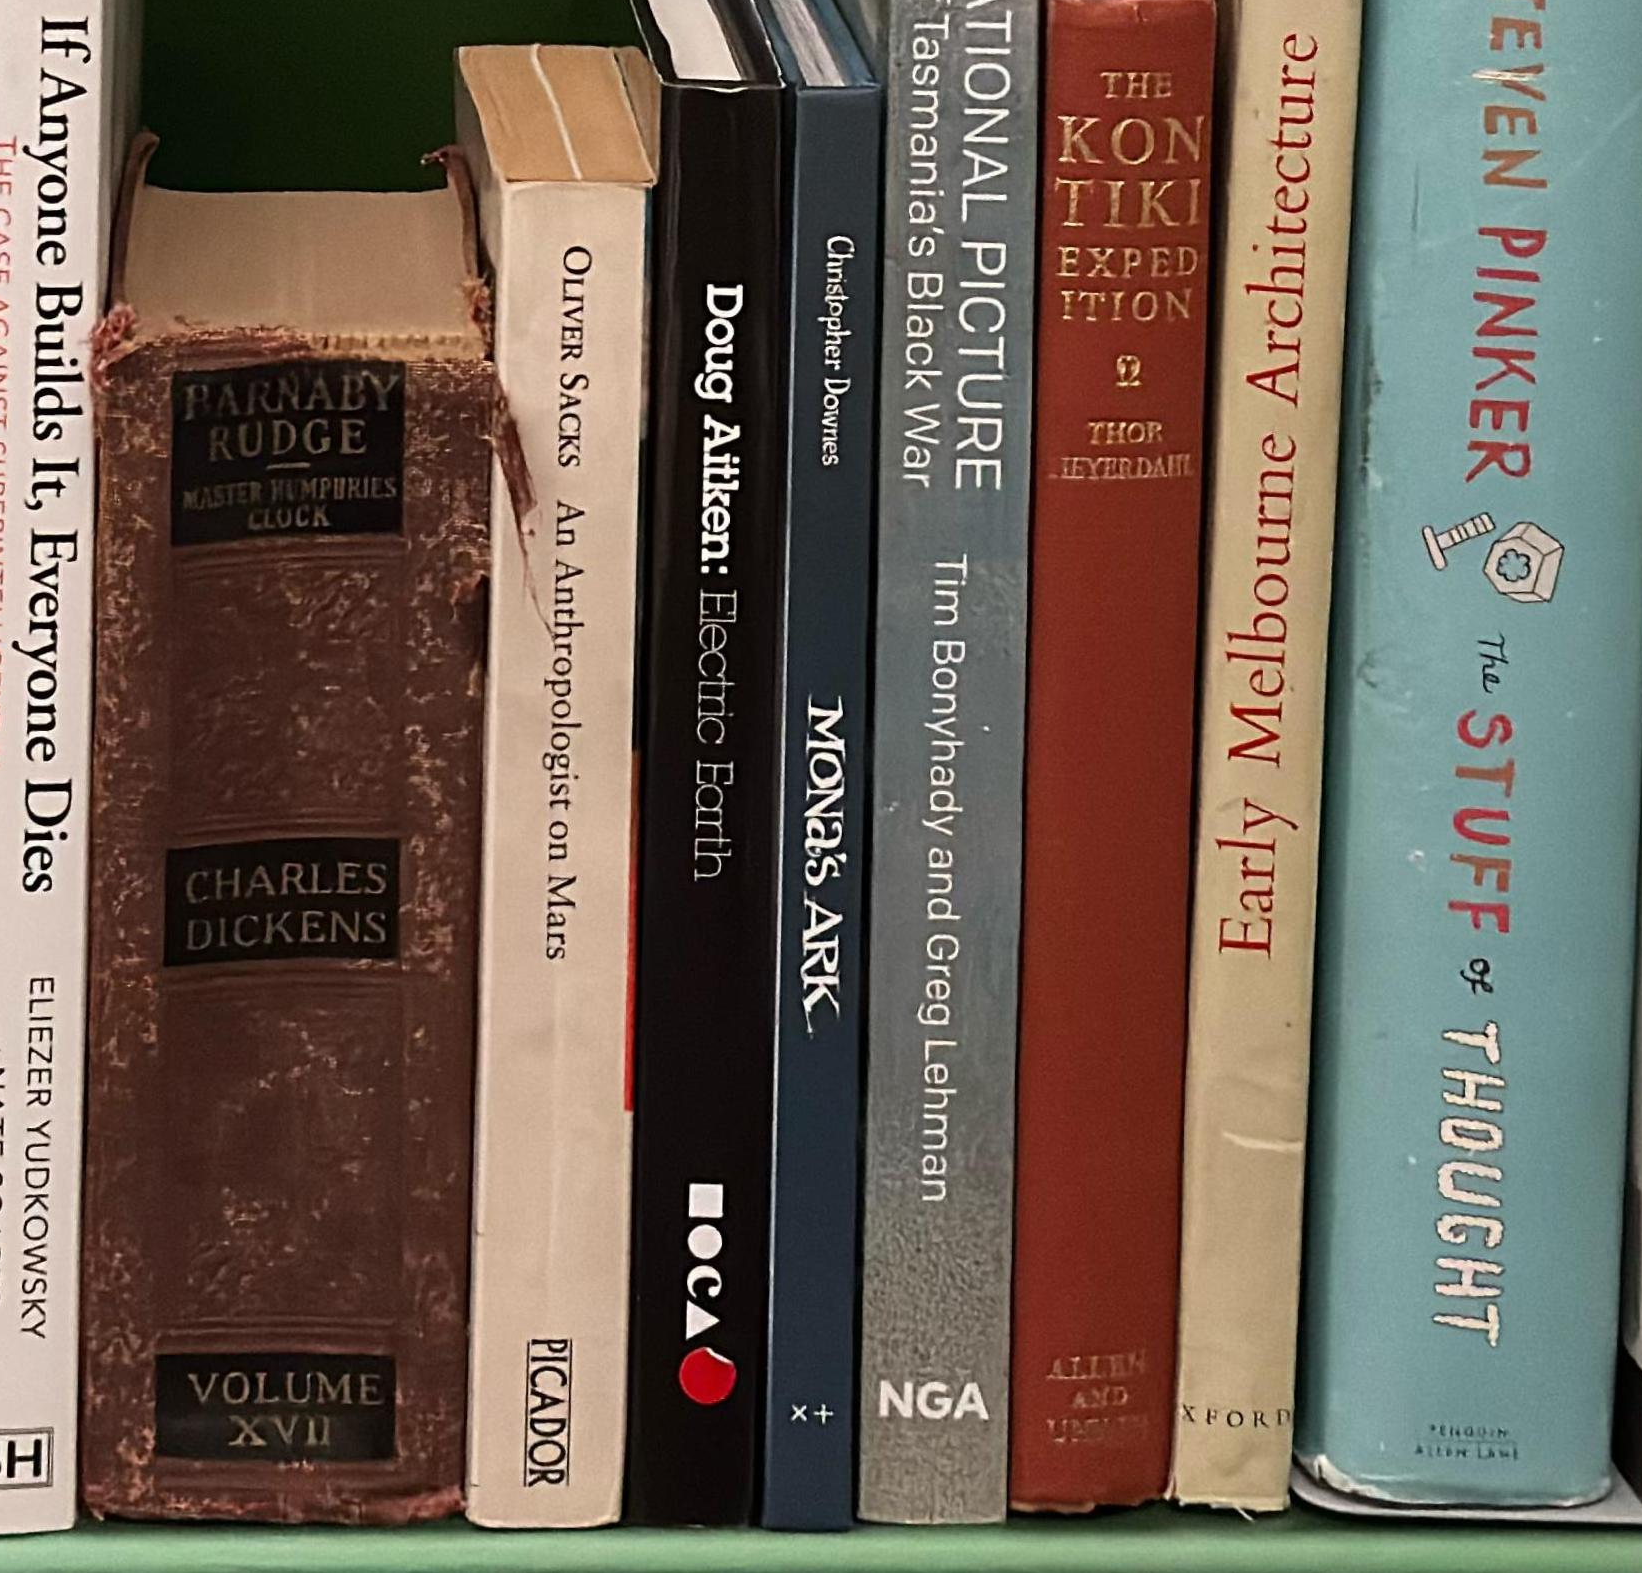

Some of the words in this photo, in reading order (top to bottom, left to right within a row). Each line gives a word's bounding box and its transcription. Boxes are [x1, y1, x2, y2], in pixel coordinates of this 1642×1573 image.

[40, 16, 92, 58] If
[1100, 71, 1173, 99] THE
[21, 69, 89, 266] Anyone
[905, 12, 949, 260] Tasmania's
[1058, 115, 1205, 165] KON
[1055, 177, 1202, 228] TIKI
[1245, 31, 1319, 407] Architecture
[817, 235, 856, 372] Christopher
[1056, 246, 1198, 277] EXPED
[1061, 290, 1192, 322] ITION
[30, 280, 84, 440] Builds
[693, 283, 744, 404] Doug
[903, 268, 945, 392] Black
[954, 241, 1008, 491] PICTURE
[1464, 226, 1550, 482] PINKER
[209, 419, 367, 462] RUDGE
[820, 377, 853, 467] Downes
[900, 401, 942, 489] War
[1088, 421, 1163, 445] THOR
[23, 457, 81, 511] It,
[182, 481, 262, 510] MASTER
[248, 504, 331, 531] CLOCK
[556, 499, 585, 547] An
[700, 415, 747, 576] Aitken:
[933, 553, 968, 626] Tim
[1226, 431, 1297, 768] Melbourne
[12, 529, 78, 763] Everyone
[542, 558, 586, 809] Anthropologist
[695, 589, 738, 745] Electric
[1477, 635, 1506, 694] The
[921, 641, 968, 838] Bonyhady
[21, 777, 73, 894] Dies
[546, 821, 571, 863] on
[693, 758, 735, 881] Earth
[1447, 709, 1515, 936] STUFF
[185, 861, 388, 904] CHARLES
[544, 874, 576, 961] Mars
[925, 848, 956, 924] and
[1218, 795, 1300, 957] Early
[186, 910, 387, 951] DICKENS
[800, 888, 844, 1038] ARK
[916, 935, 961, 1029] Greg
[1459, 957, 1495, 995] of
[27, 976, 55, 1107] ELIEZER
[920, 1037, 958, 1205] Lehman
[19, 1119, 52, 1339] YUDKOWSKY
[1432, 1021, 1505, 1348] THOUGHT
[188, 1372, 383, 1406] VOLUME
[228, 1414, 331, 1446] XVII
[529, 1339, 569, 1487] PICADOR
[879, 1380, 989, 1421] NGA
[1073, 1386, 1129, 1408] AND
[1182, 1404, 1290, 1428] XFORD
